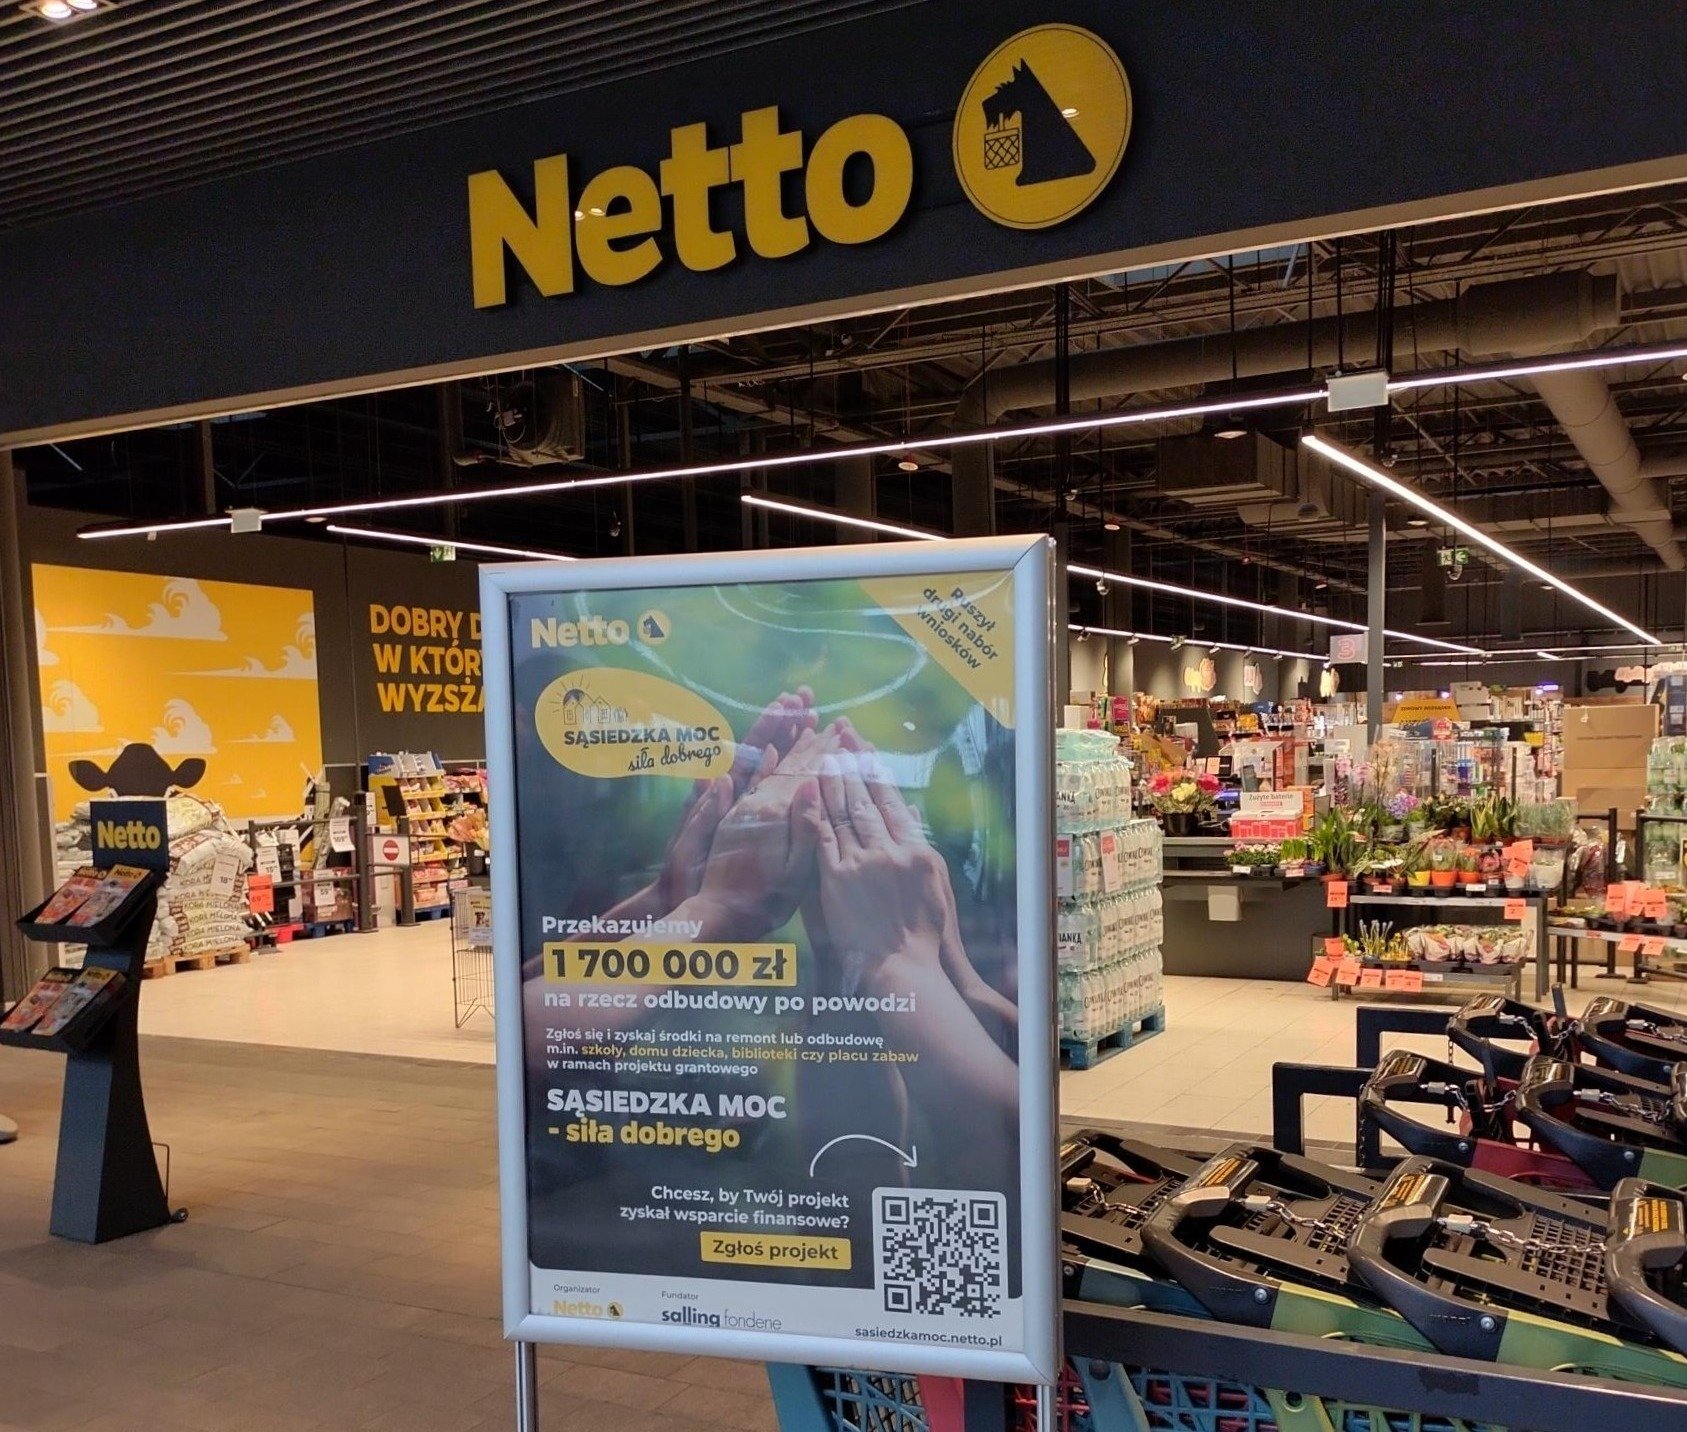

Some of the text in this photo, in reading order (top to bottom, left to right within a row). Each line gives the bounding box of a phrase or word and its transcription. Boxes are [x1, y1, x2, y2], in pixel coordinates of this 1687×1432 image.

[467, 105, 914, 309] Netto
[370, 604, 463, 638] DOBRY
[951, 587, 996, 632] Ruszył
[531, 614, 630, 648] Netto
[923, 588, 999, 661] drugi nabór
[917, 606, 982, 669] wniosków
[372, 639, 482, 676] W KTÓR
[564, 726, 720, 749] SĄSIEDZKA MOC
[628, 743, 722, 772] siła dobrego
[97, 821, 161, 850] Netto
[542, 915, 703, 938] Przekazujemy
[552, 949, 787, 980] 1 700 000 zł
[544, 990, 916, 1015] na rzecz odbudowy po powodzi
[546, 1027, 884, 1048] Zgłoś się i zyskaj środki na remont lub odbudowę
[547, 1044, 919, 1063] m.in. szkoły, domu dziecka, biblioteki czy placu zabaw
[547, 1059, 758, 1077] w ramach projektu grantowego
[547, 1088, 787, 1119] SĄSIEDZKA MOC
[548, 1117, 740, 1153] - siła dobrego
[651, 1185, 849, 1209] Chcesz, by Twój projekt
[620, 1204, 849, 1229] zyskał wsparcie finansowe?
[712, 1239, 839, 1262] Zgłoś projekt
[553, 1283, 600, 1294] Organizator
[661, 1290, 699, 1301] Fundator
[553, 1300, 603, 1316] Netto
[662, 1306, 782, 1330] salling fondene
[855, 1326, 1002, 1348] sasiedzkamoc.netto.pl
